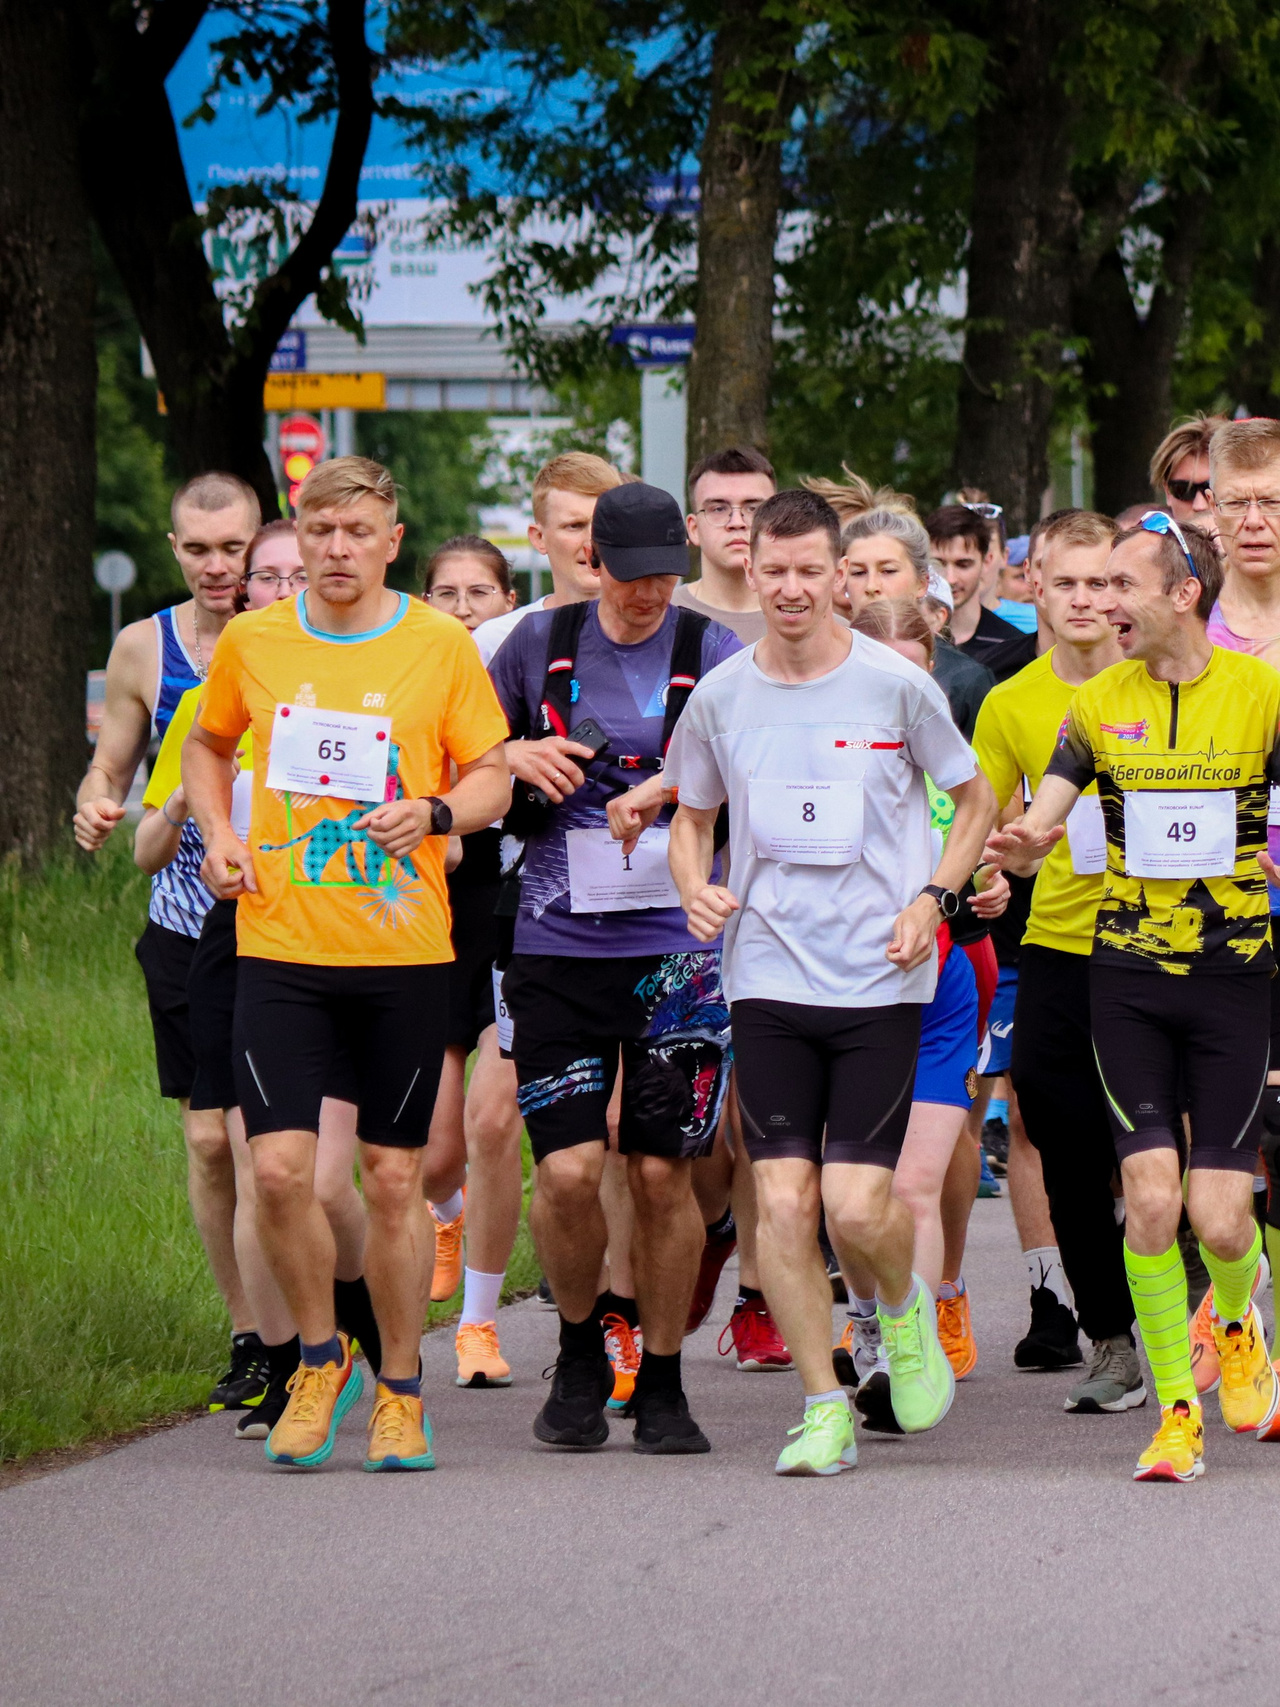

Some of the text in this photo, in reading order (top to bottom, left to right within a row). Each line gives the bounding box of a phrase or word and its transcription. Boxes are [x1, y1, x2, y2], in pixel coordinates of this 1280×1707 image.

[318, 739, 346, 761] 65
[802, 802, 816, 822] 8
[1166, 821, 1197, 842] 49
[622, 854, 633, 871] 1
